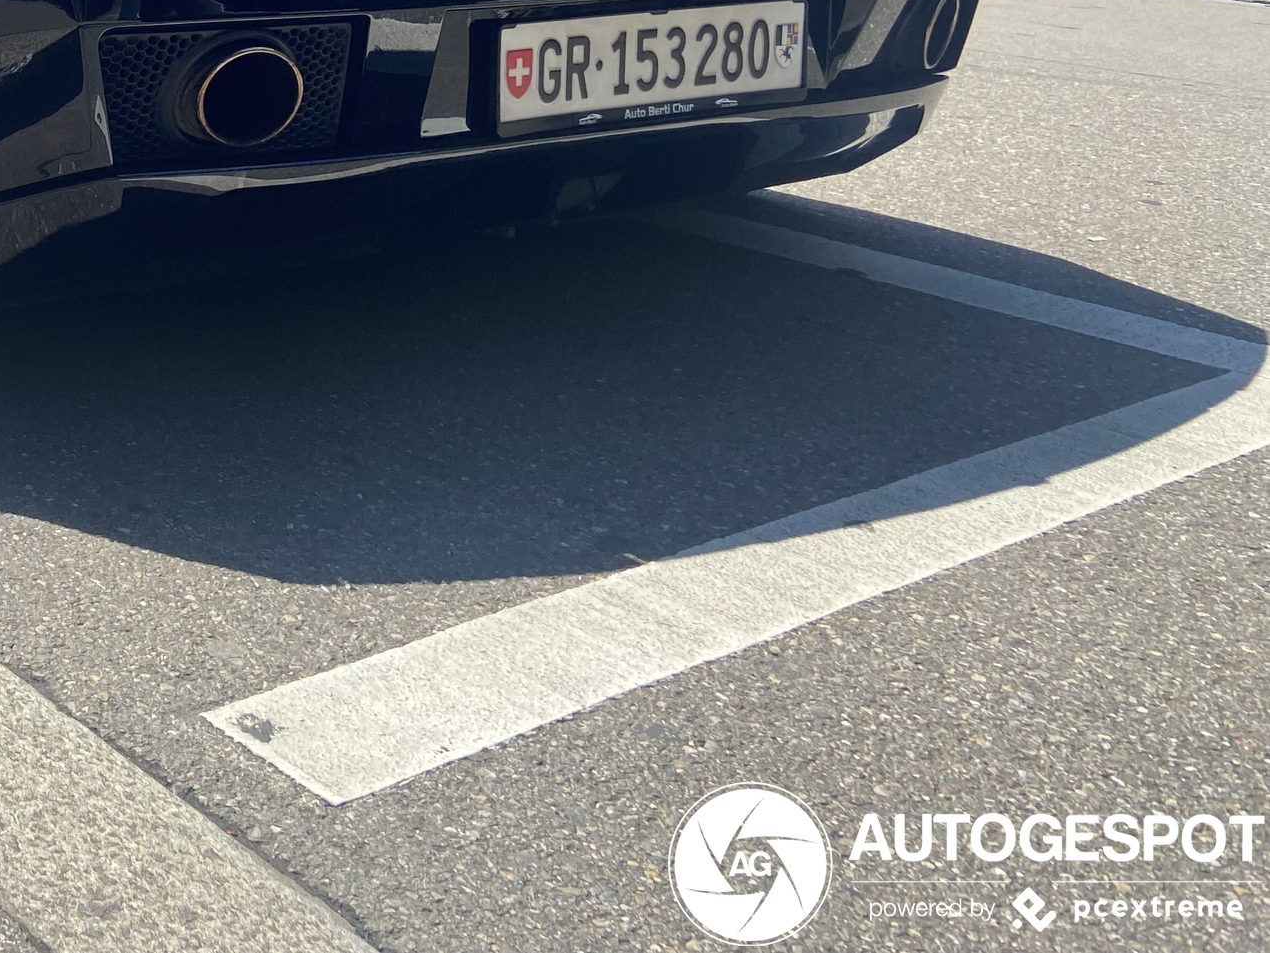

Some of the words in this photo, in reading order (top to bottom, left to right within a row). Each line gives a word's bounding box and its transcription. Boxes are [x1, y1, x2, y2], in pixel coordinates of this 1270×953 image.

[624, 108, 646, 120] Auto
[648, 103, 671, 117] Berti
[673, 102, 695, 114] Chur
